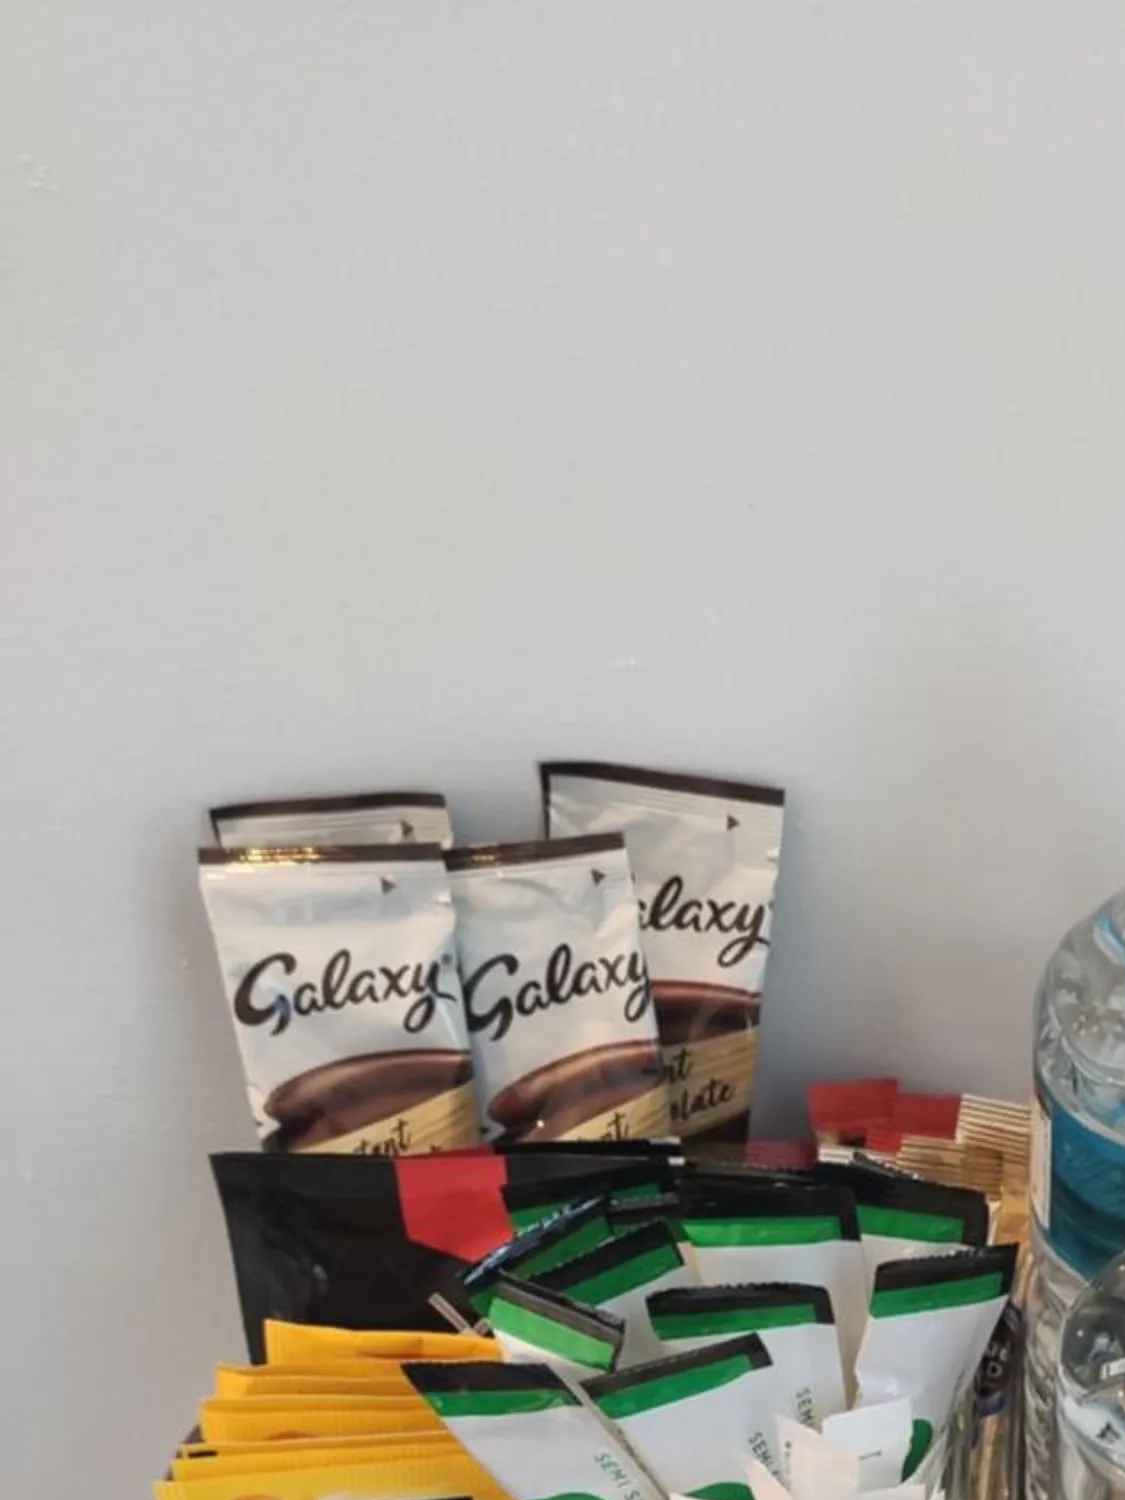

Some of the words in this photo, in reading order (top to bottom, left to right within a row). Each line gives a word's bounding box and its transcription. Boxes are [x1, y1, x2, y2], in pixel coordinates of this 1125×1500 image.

[638, 874, 770, 968] laxy
[234, 949, 457, 1035] Galaxy
[466, 943, 650, 1041] Galaxy
[795, 1387, 814, 1426] SEM
[594, 1452, 629, 1488] SEMI
